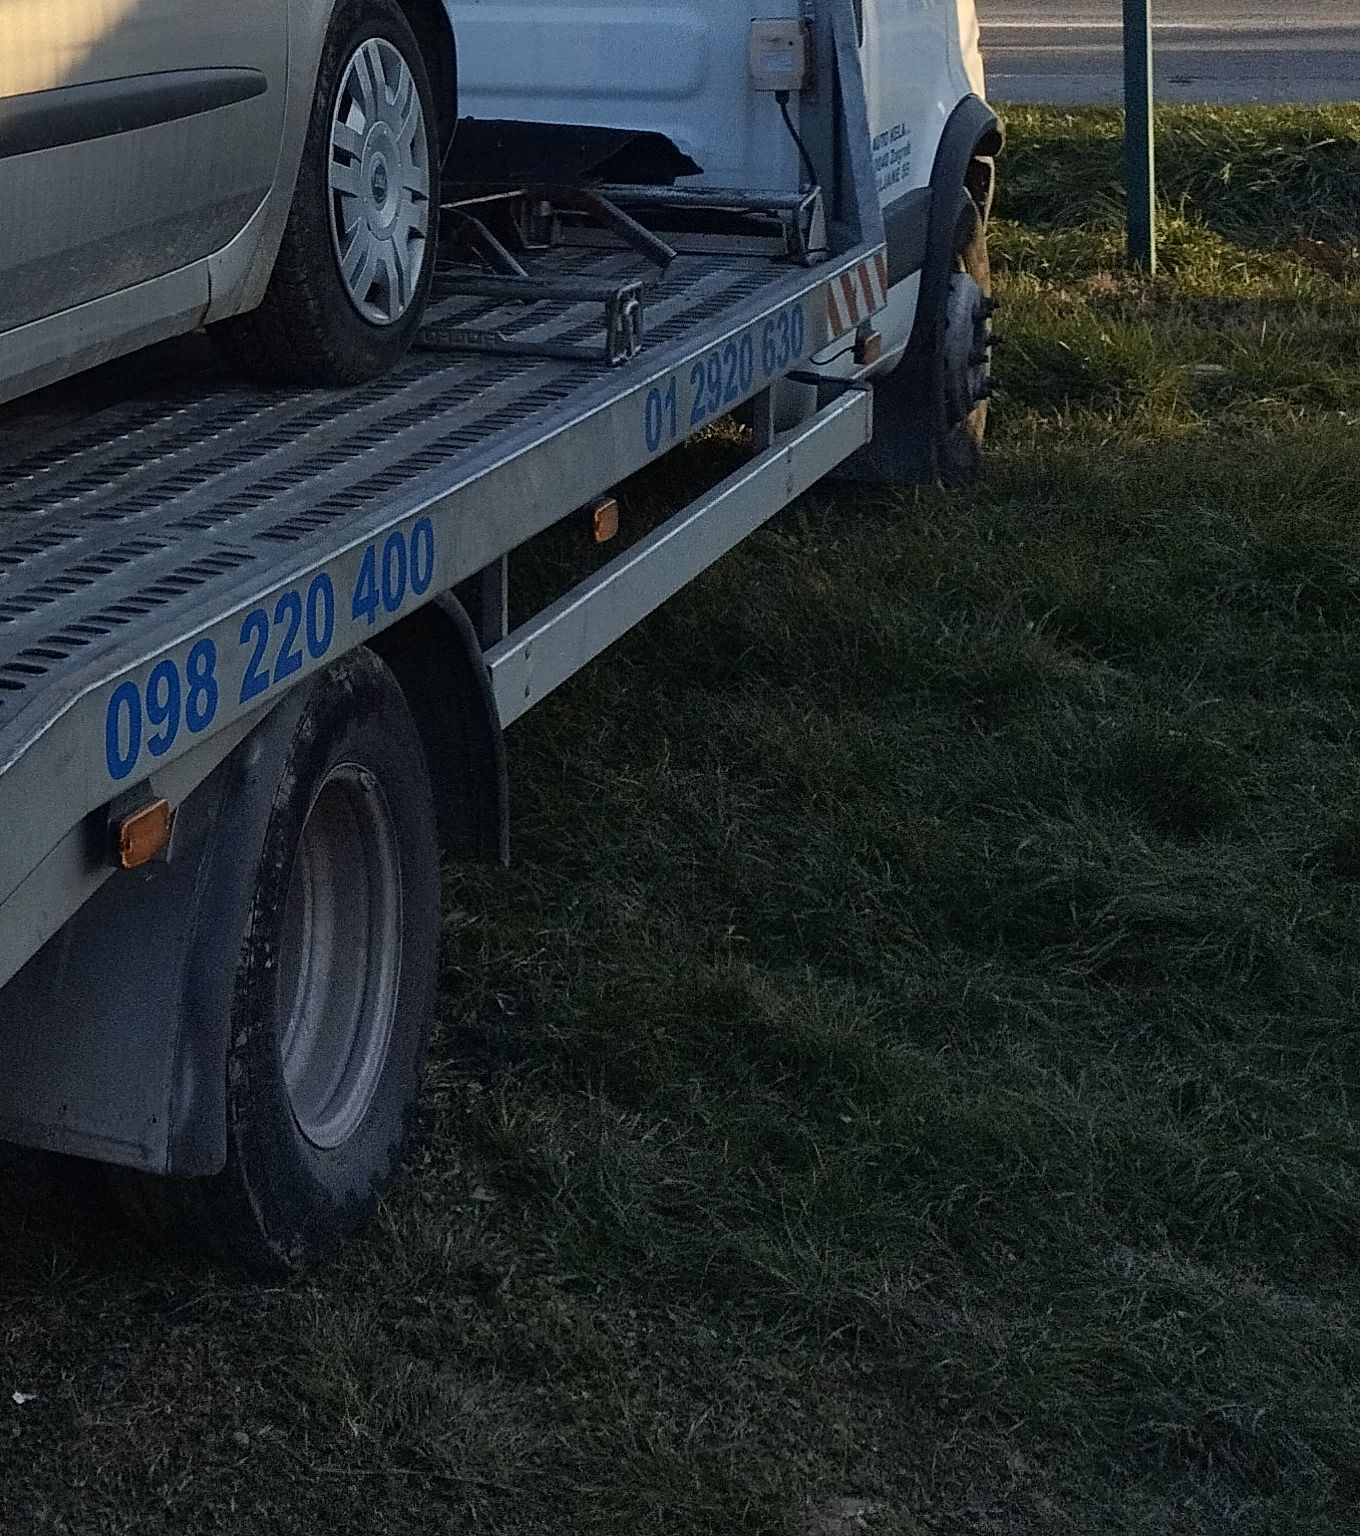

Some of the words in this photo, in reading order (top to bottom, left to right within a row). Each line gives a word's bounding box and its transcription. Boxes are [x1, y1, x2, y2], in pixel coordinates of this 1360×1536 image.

[644, 375, 677, 454] 01
[689, 333, 754, 427] 2920
[761, 303, 805, 380] 630
[105, 637, 219, 781] 098
[239, 572, 335, 705] 220
[351, 516, 435, 625] 400
